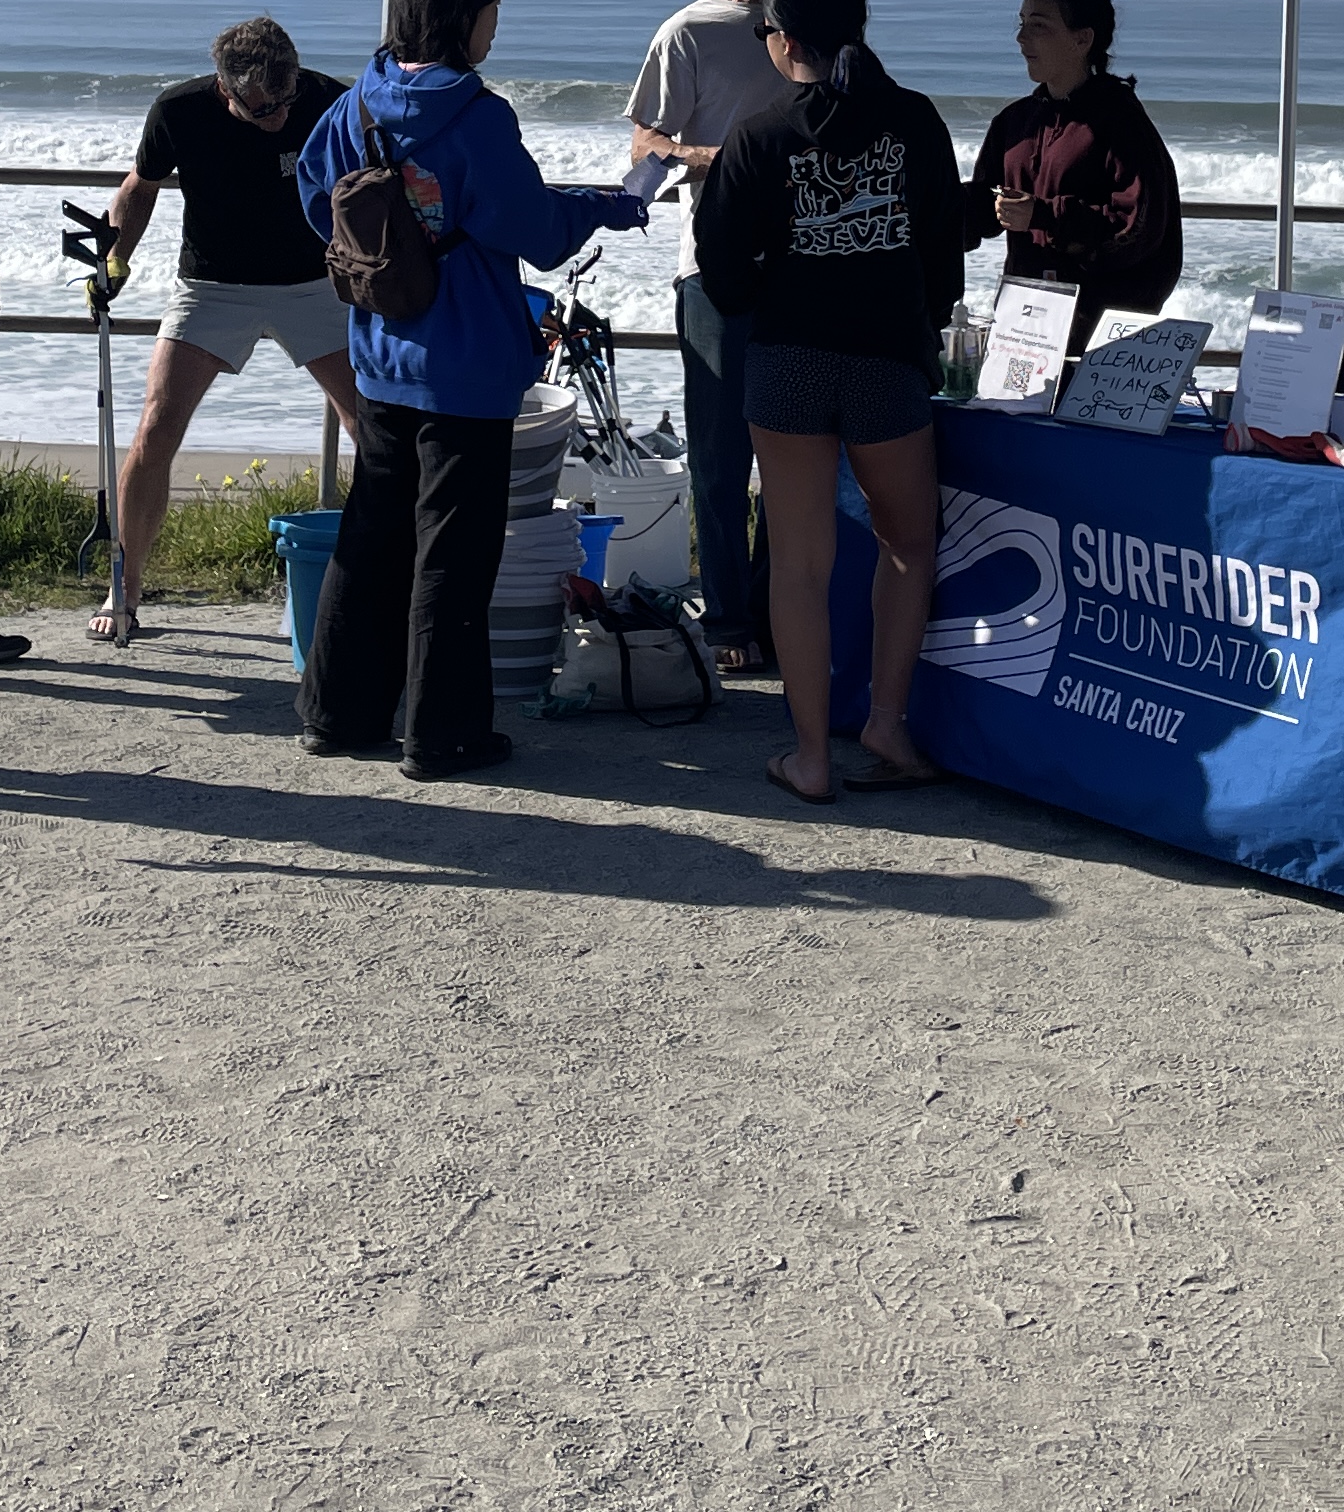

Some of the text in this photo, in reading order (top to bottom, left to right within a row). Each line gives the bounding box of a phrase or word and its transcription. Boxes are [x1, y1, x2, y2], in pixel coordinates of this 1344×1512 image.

[995, 332, 1021, 344] Volunteer
[1107, 322, 1172, 347] BEACH
[1088, 347, 1184, 377] CLEANUP!
[1071, 521, 1322, 645] SURFRIDER
[1073, 596, 1314, 700] FOUNDATION
[1053, 675, 1186, 746] SANTA CRUZ
